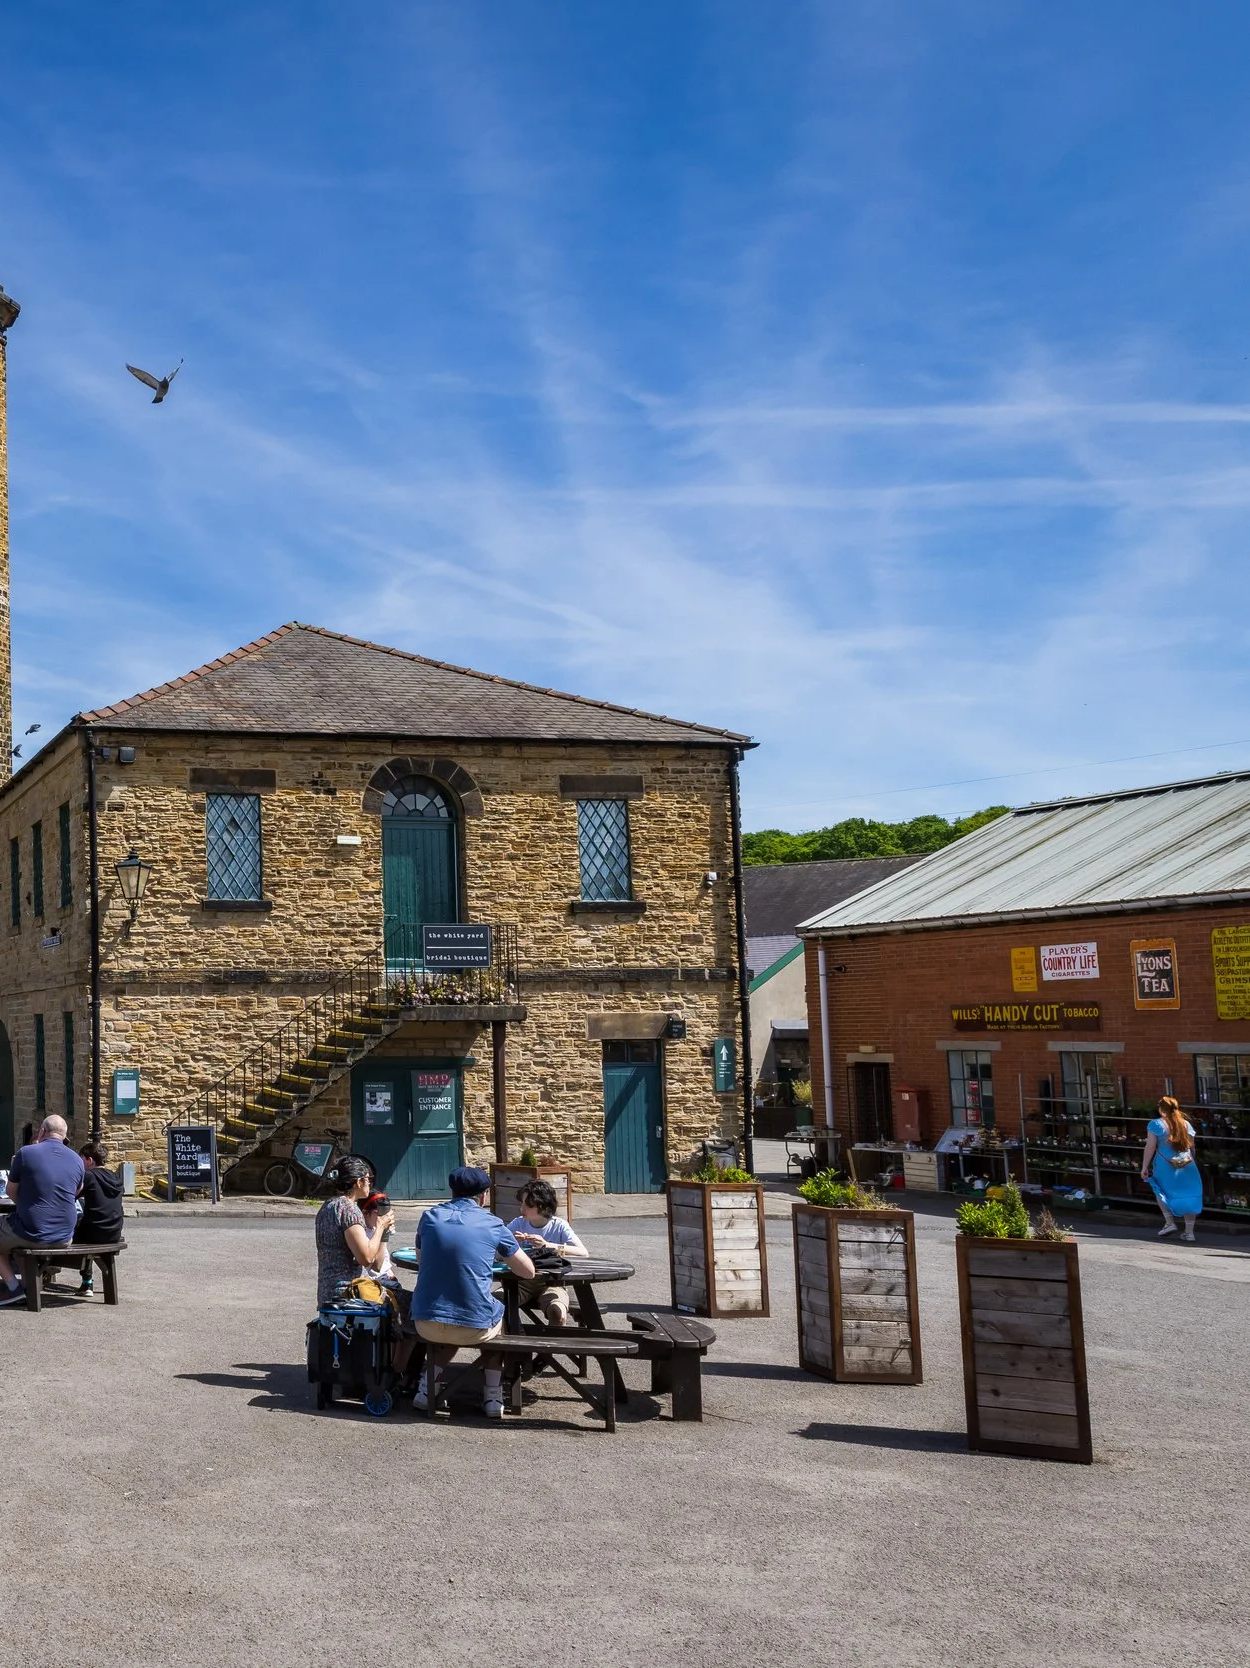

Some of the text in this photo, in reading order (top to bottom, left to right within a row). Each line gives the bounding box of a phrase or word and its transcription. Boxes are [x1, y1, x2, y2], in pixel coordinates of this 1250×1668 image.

[1049, 945, 1088, 956] PLAYER'S
[1141, 978, 1170, 992] TEA
[1063, 1007, 1099, 1017] TOBACCO
[418, 1096, 452, 1104] CUSTOMER
[174, 1134, 191, 1142] The
